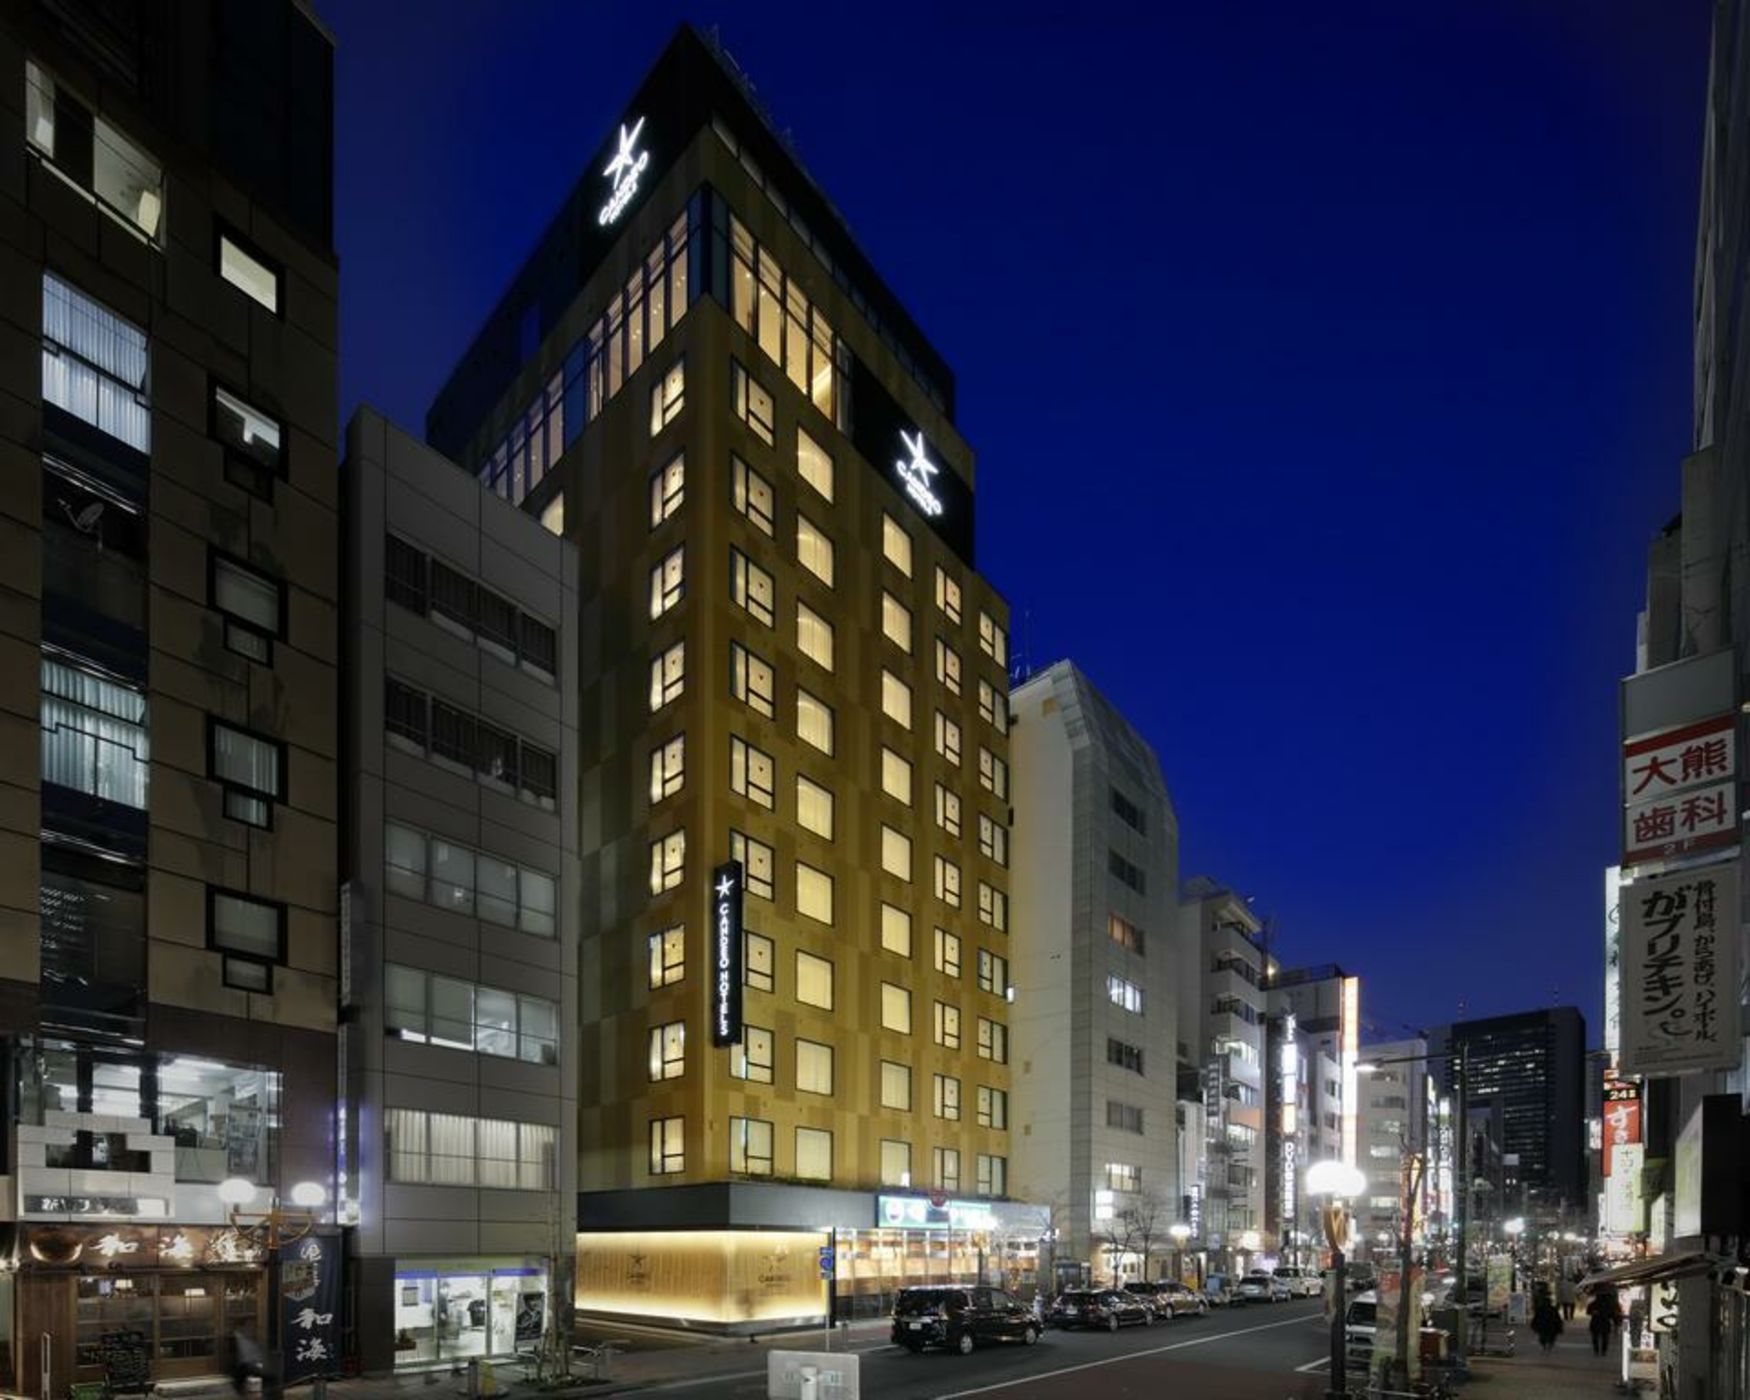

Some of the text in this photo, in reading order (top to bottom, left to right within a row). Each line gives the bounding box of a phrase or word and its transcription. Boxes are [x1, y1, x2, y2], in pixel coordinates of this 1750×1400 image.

[1632, 738, 1727, 795] 大熊
[1633, 790, 1727, 843] 歯科
[719, 902, 730, 1036] CANDEO HOTELS
